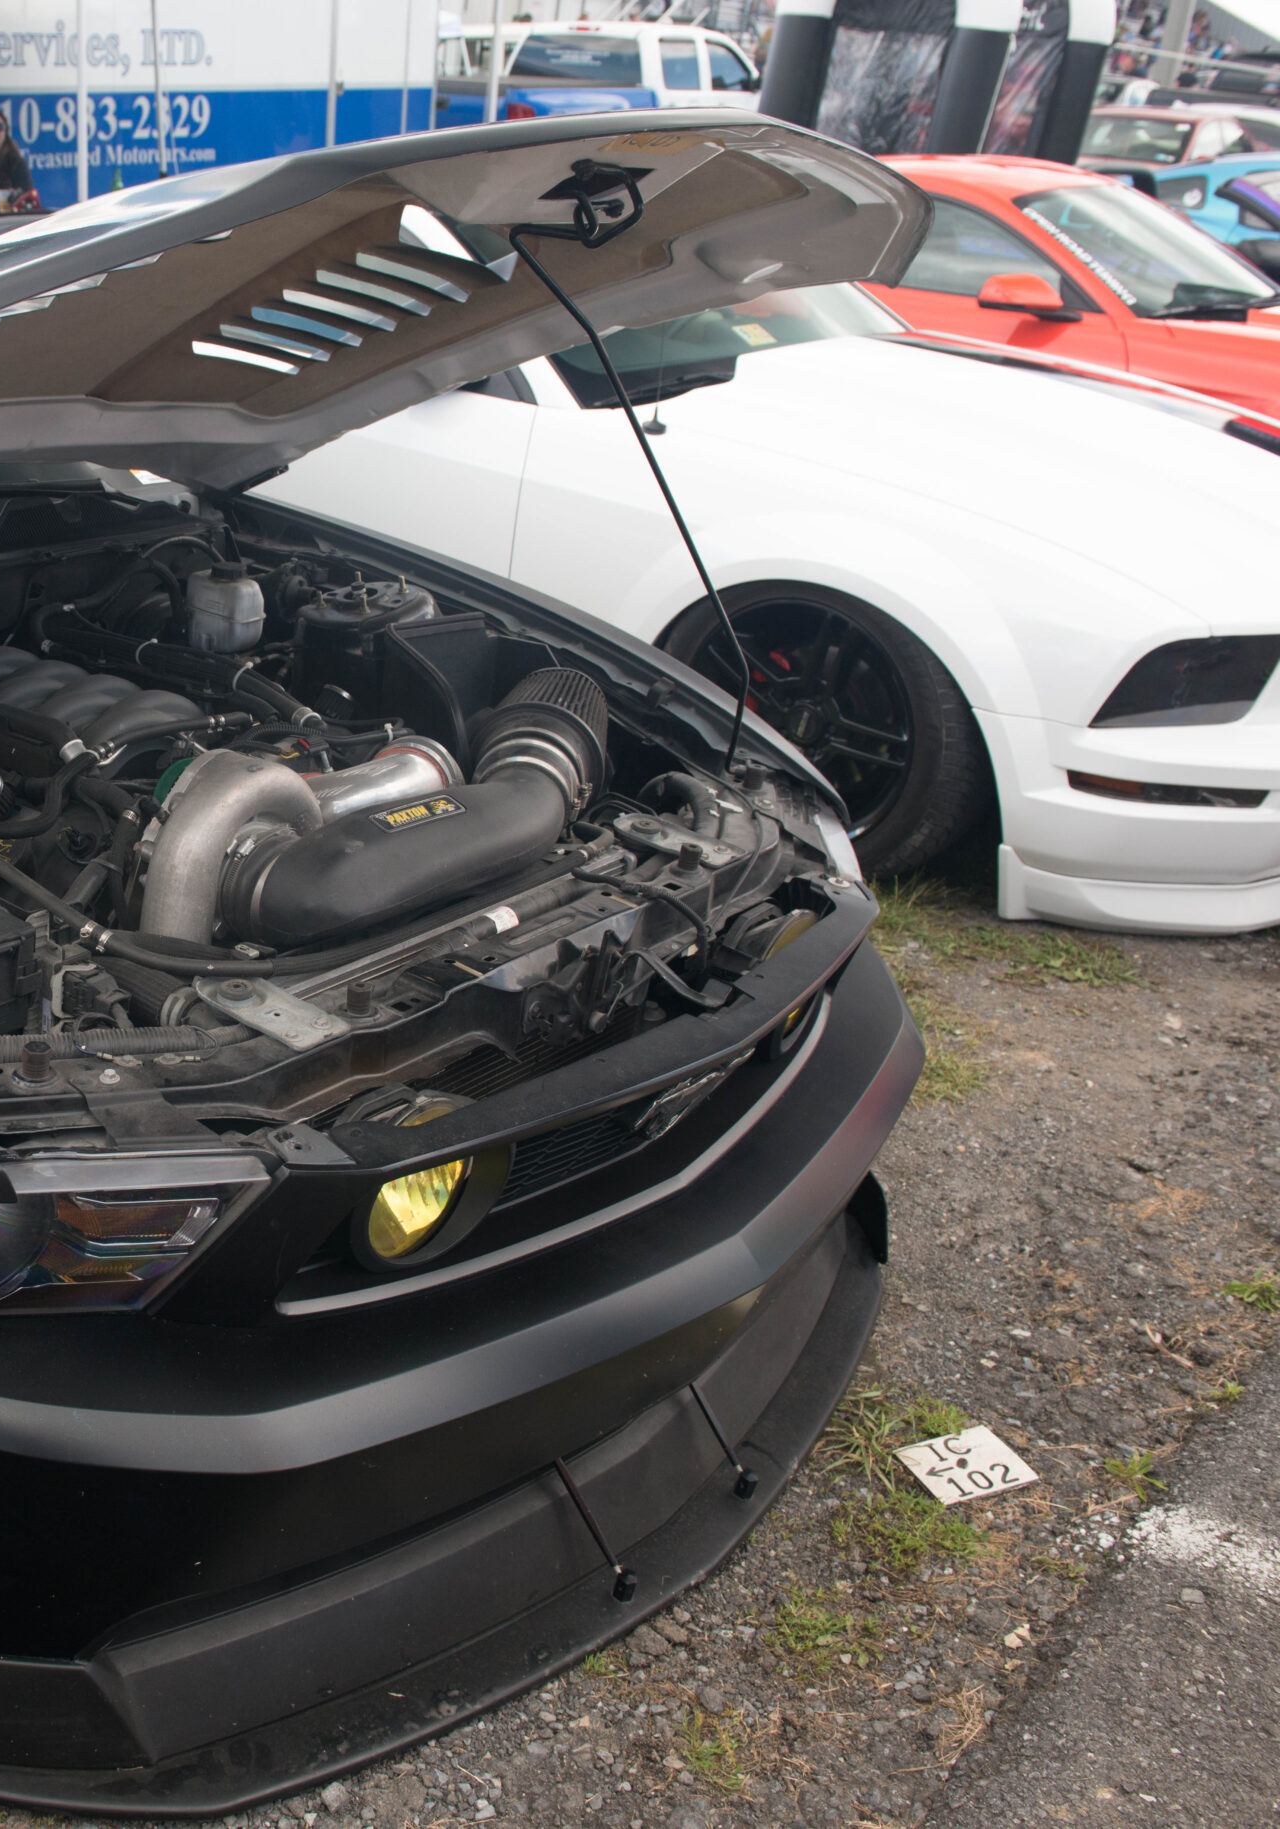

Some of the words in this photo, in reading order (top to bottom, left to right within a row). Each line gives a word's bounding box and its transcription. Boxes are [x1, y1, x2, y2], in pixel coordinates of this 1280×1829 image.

[140, 27, 213, 67] LTD.
[20, 144, 101, 170] Treasud
[386, 805, 429, 825] PAXTON
[947, 1463, 1020, 1497] 102
